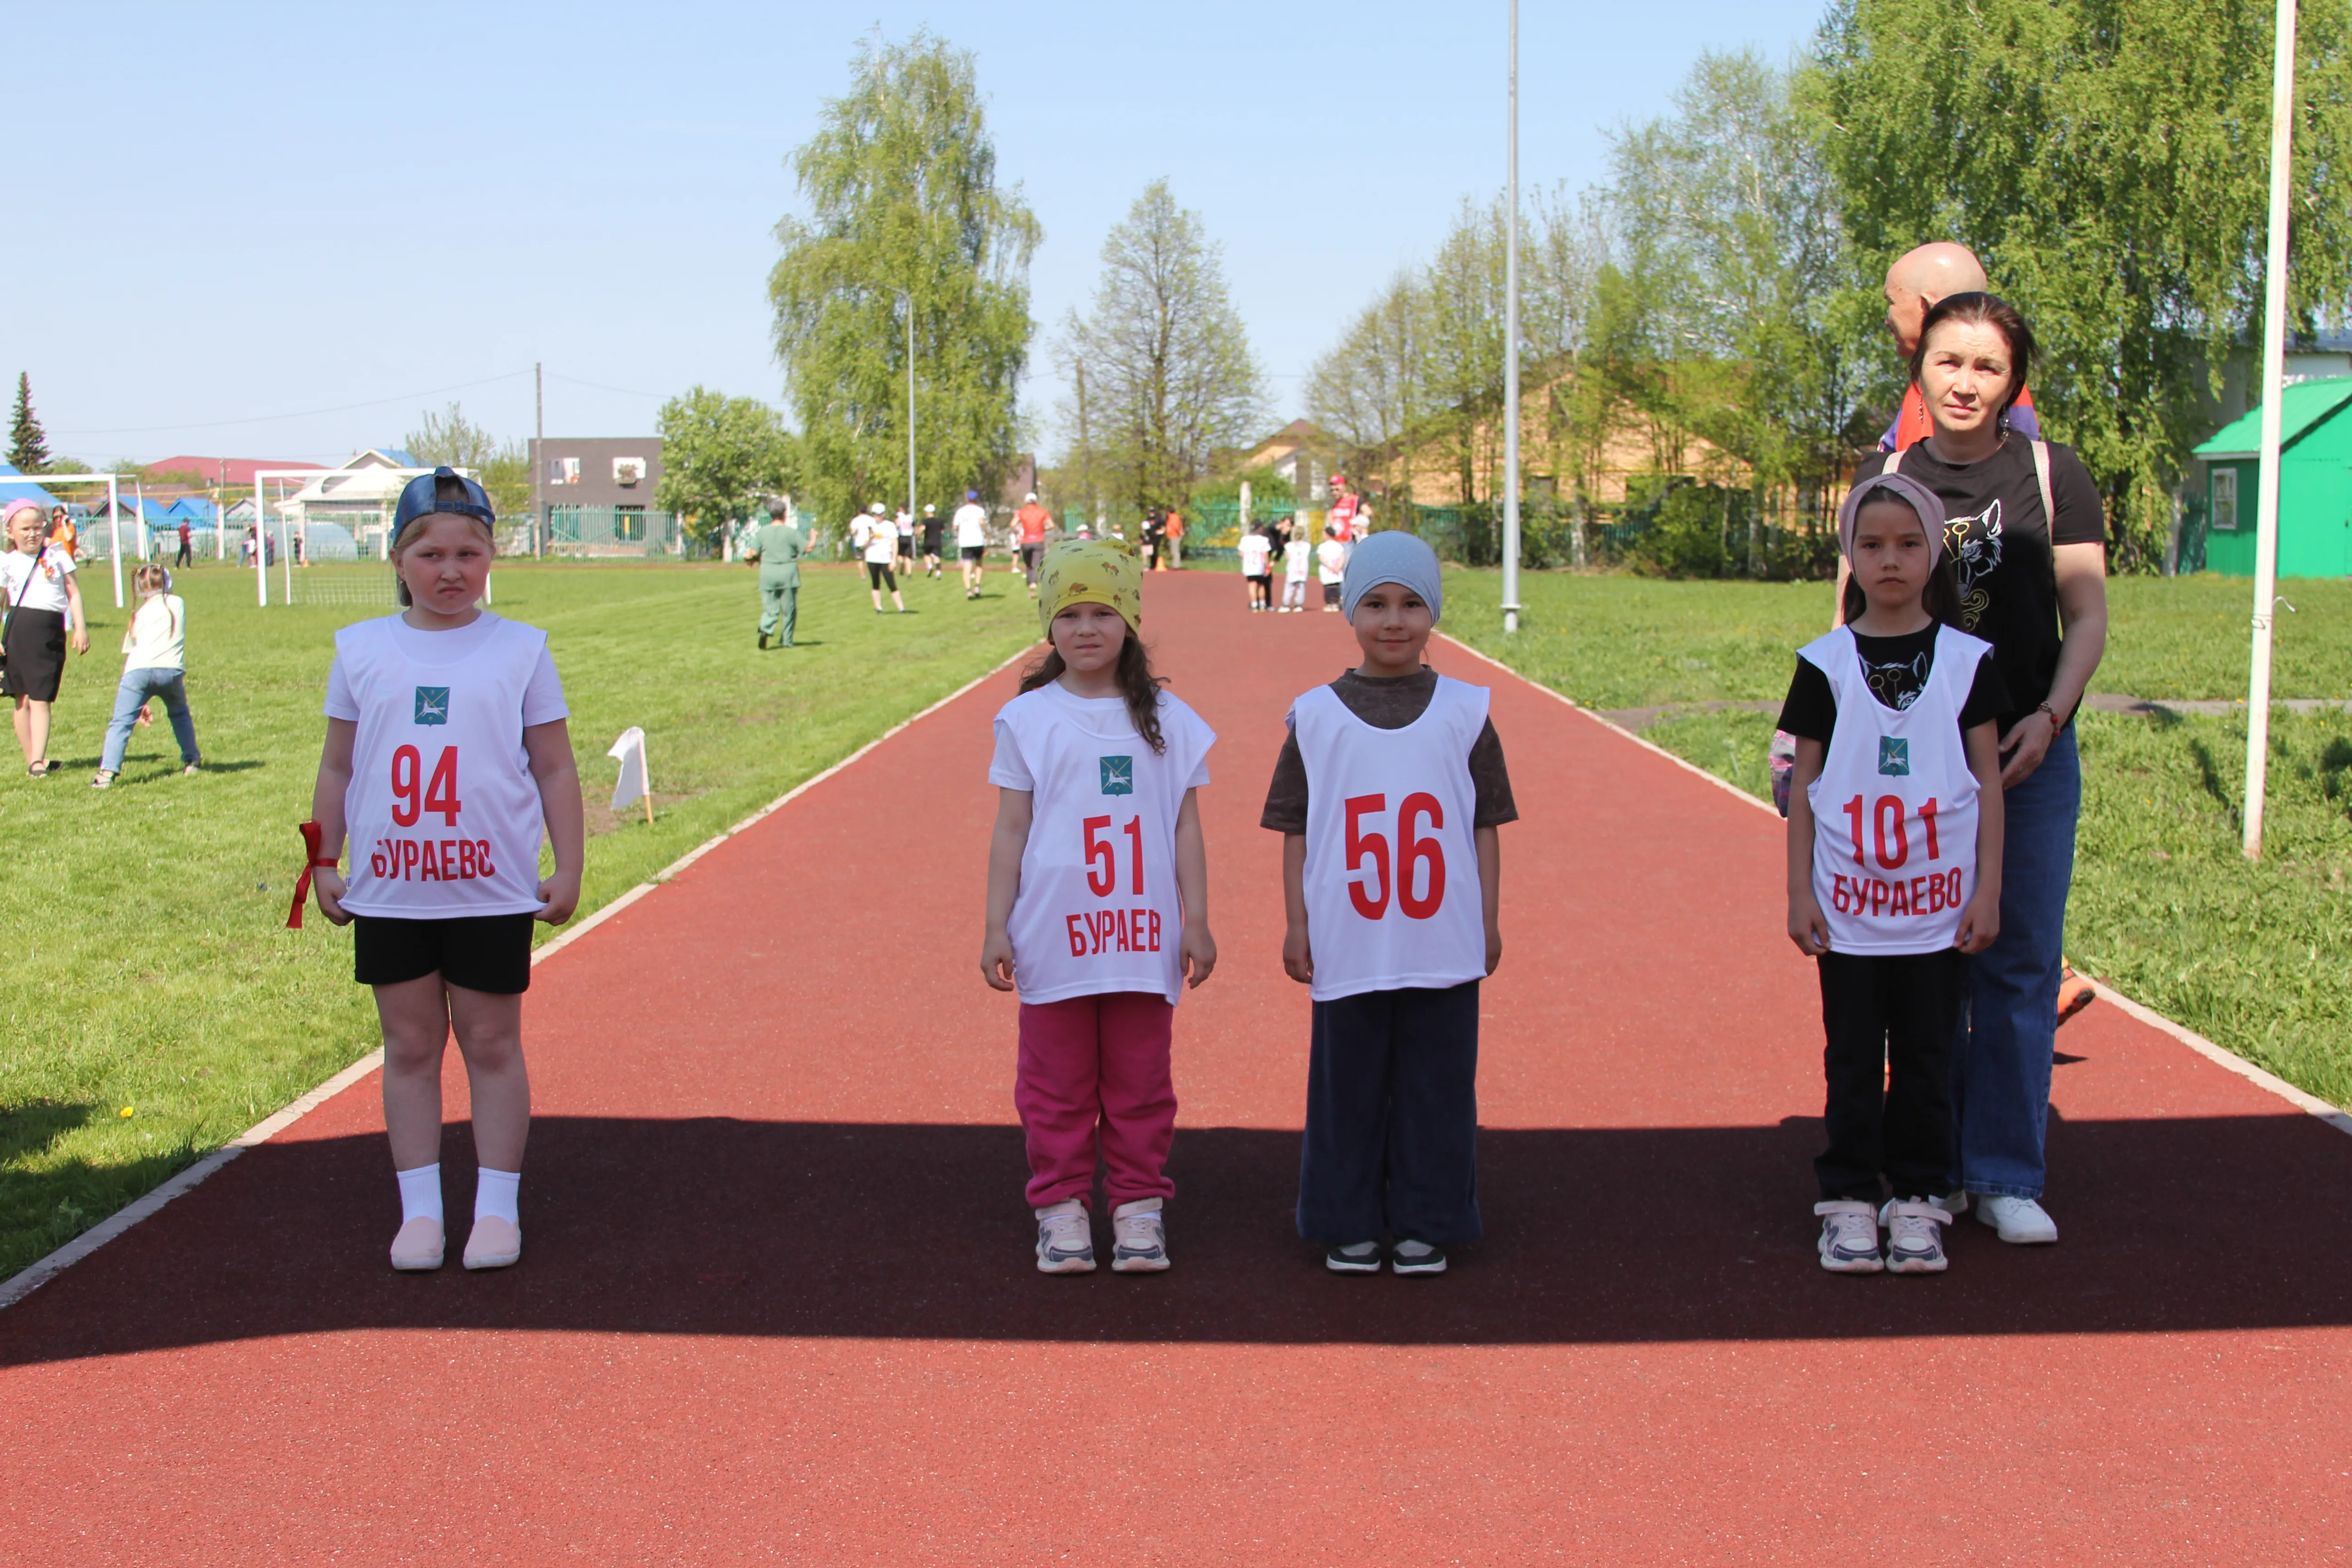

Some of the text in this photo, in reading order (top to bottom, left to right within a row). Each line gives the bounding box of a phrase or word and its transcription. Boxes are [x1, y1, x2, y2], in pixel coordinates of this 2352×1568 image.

[392, 745, 461, 827] 94
[371, 838, 496, 882] БУРАЕВО
[1083, 815, 1144, 897] 51
[1345, 792, 1446, 920] 56
[1843, 794, 1939, 870] 101
[1833, 867, 1962, 916] БУРАЕВО
